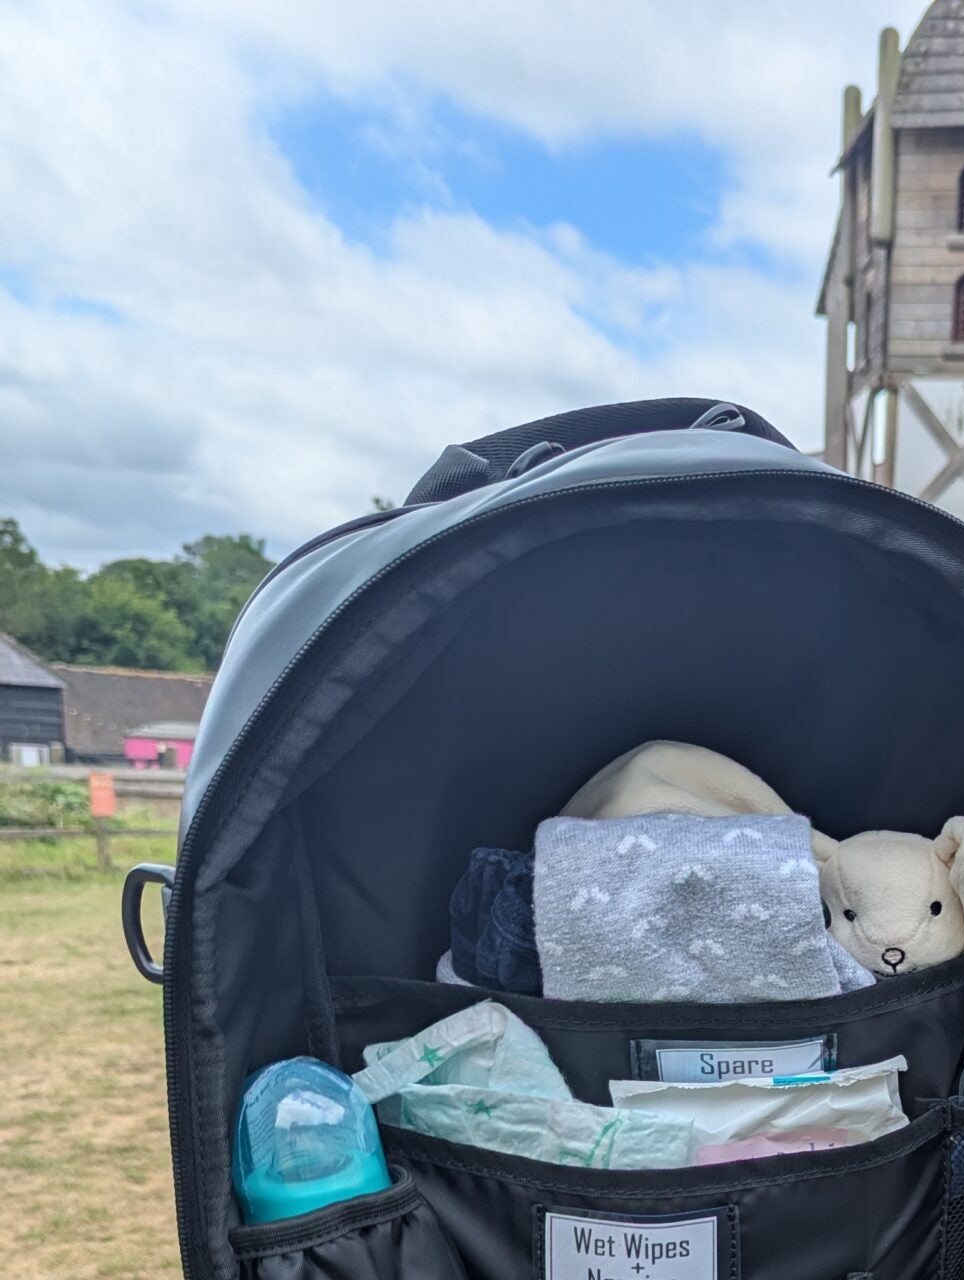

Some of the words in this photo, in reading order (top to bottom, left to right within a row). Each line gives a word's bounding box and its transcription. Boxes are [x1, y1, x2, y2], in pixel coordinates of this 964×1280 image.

[700, 1053, 774, 1080] Spare
[573, 1226, 616, 1257] Wet
[624, 1232, 690, 1265] Wipes
[631, 1262, 645, 1275] +
